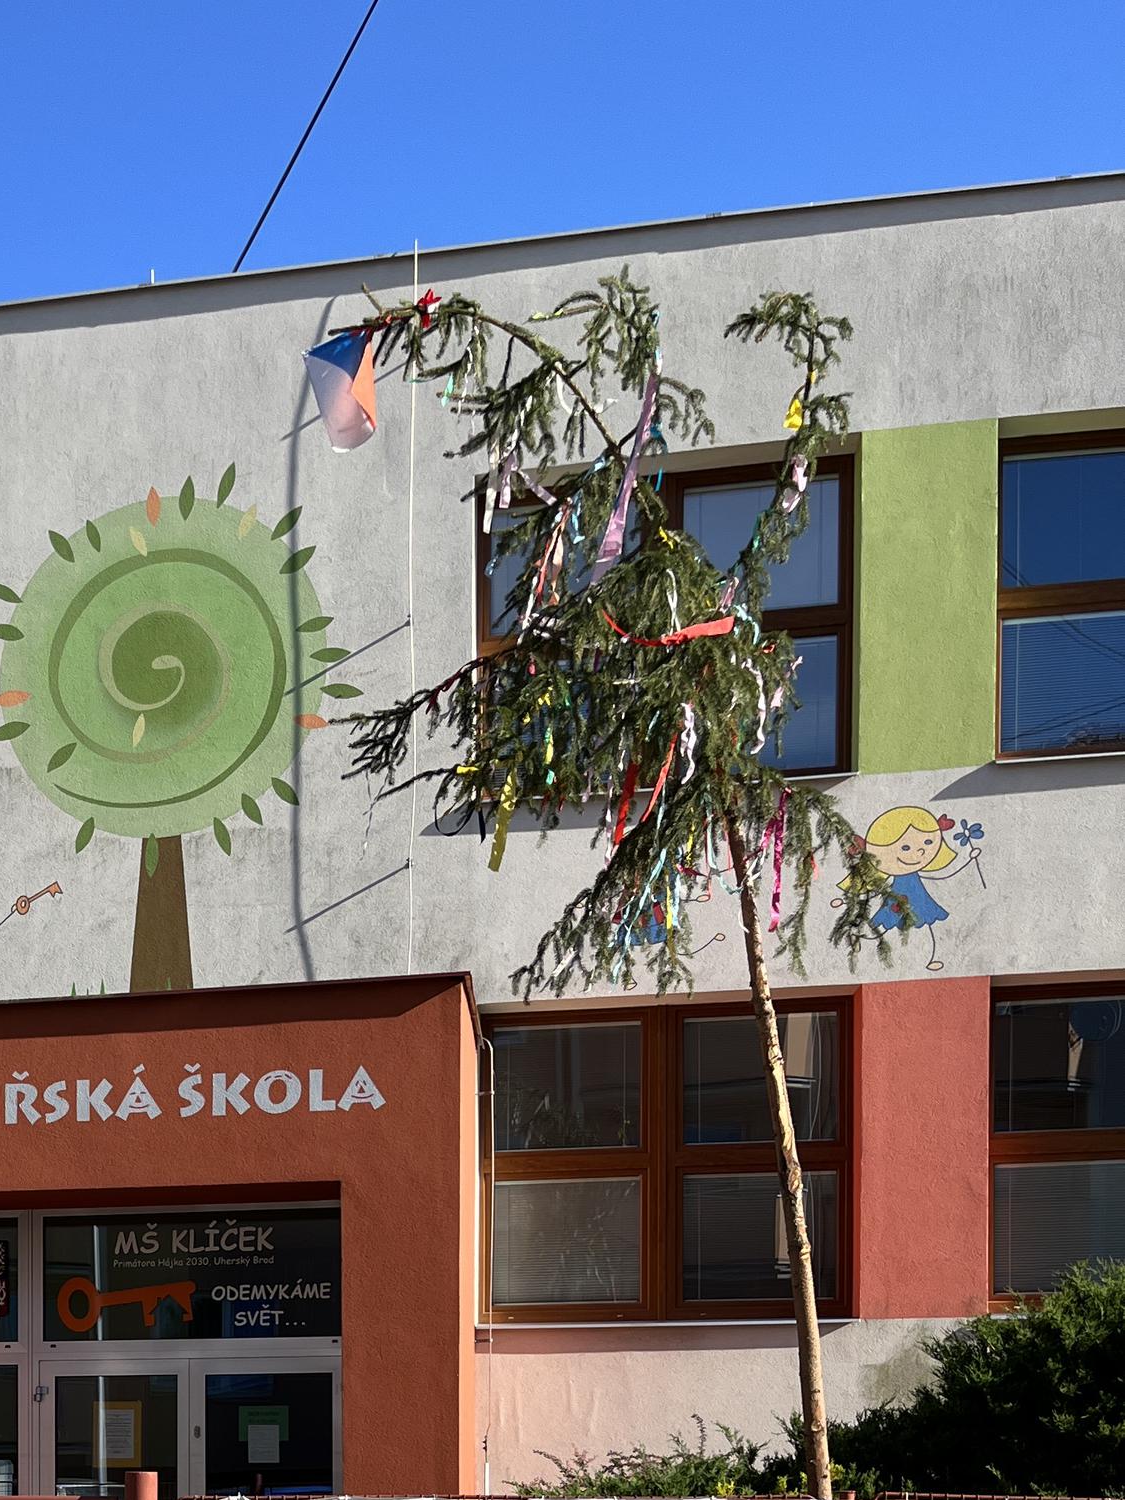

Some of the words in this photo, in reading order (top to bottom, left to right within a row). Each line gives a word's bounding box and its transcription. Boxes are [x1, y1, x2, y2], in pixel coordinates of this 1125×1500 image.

[178, 1063, 386, 1118] ŠKOLA
[114, 1223, 160, 1254] MŠ
[172, 1219, 275, 1253] KLÍČEK
[113, 1256, 156, 1268] Primátora
[158, 1257, 184, 1269] Hájka
[214, 1255, 251, 1267] Uherský
[253, 1255, 275, 1265] Brod
[211, 1279, 331, 1301] ODEMYKÁME
